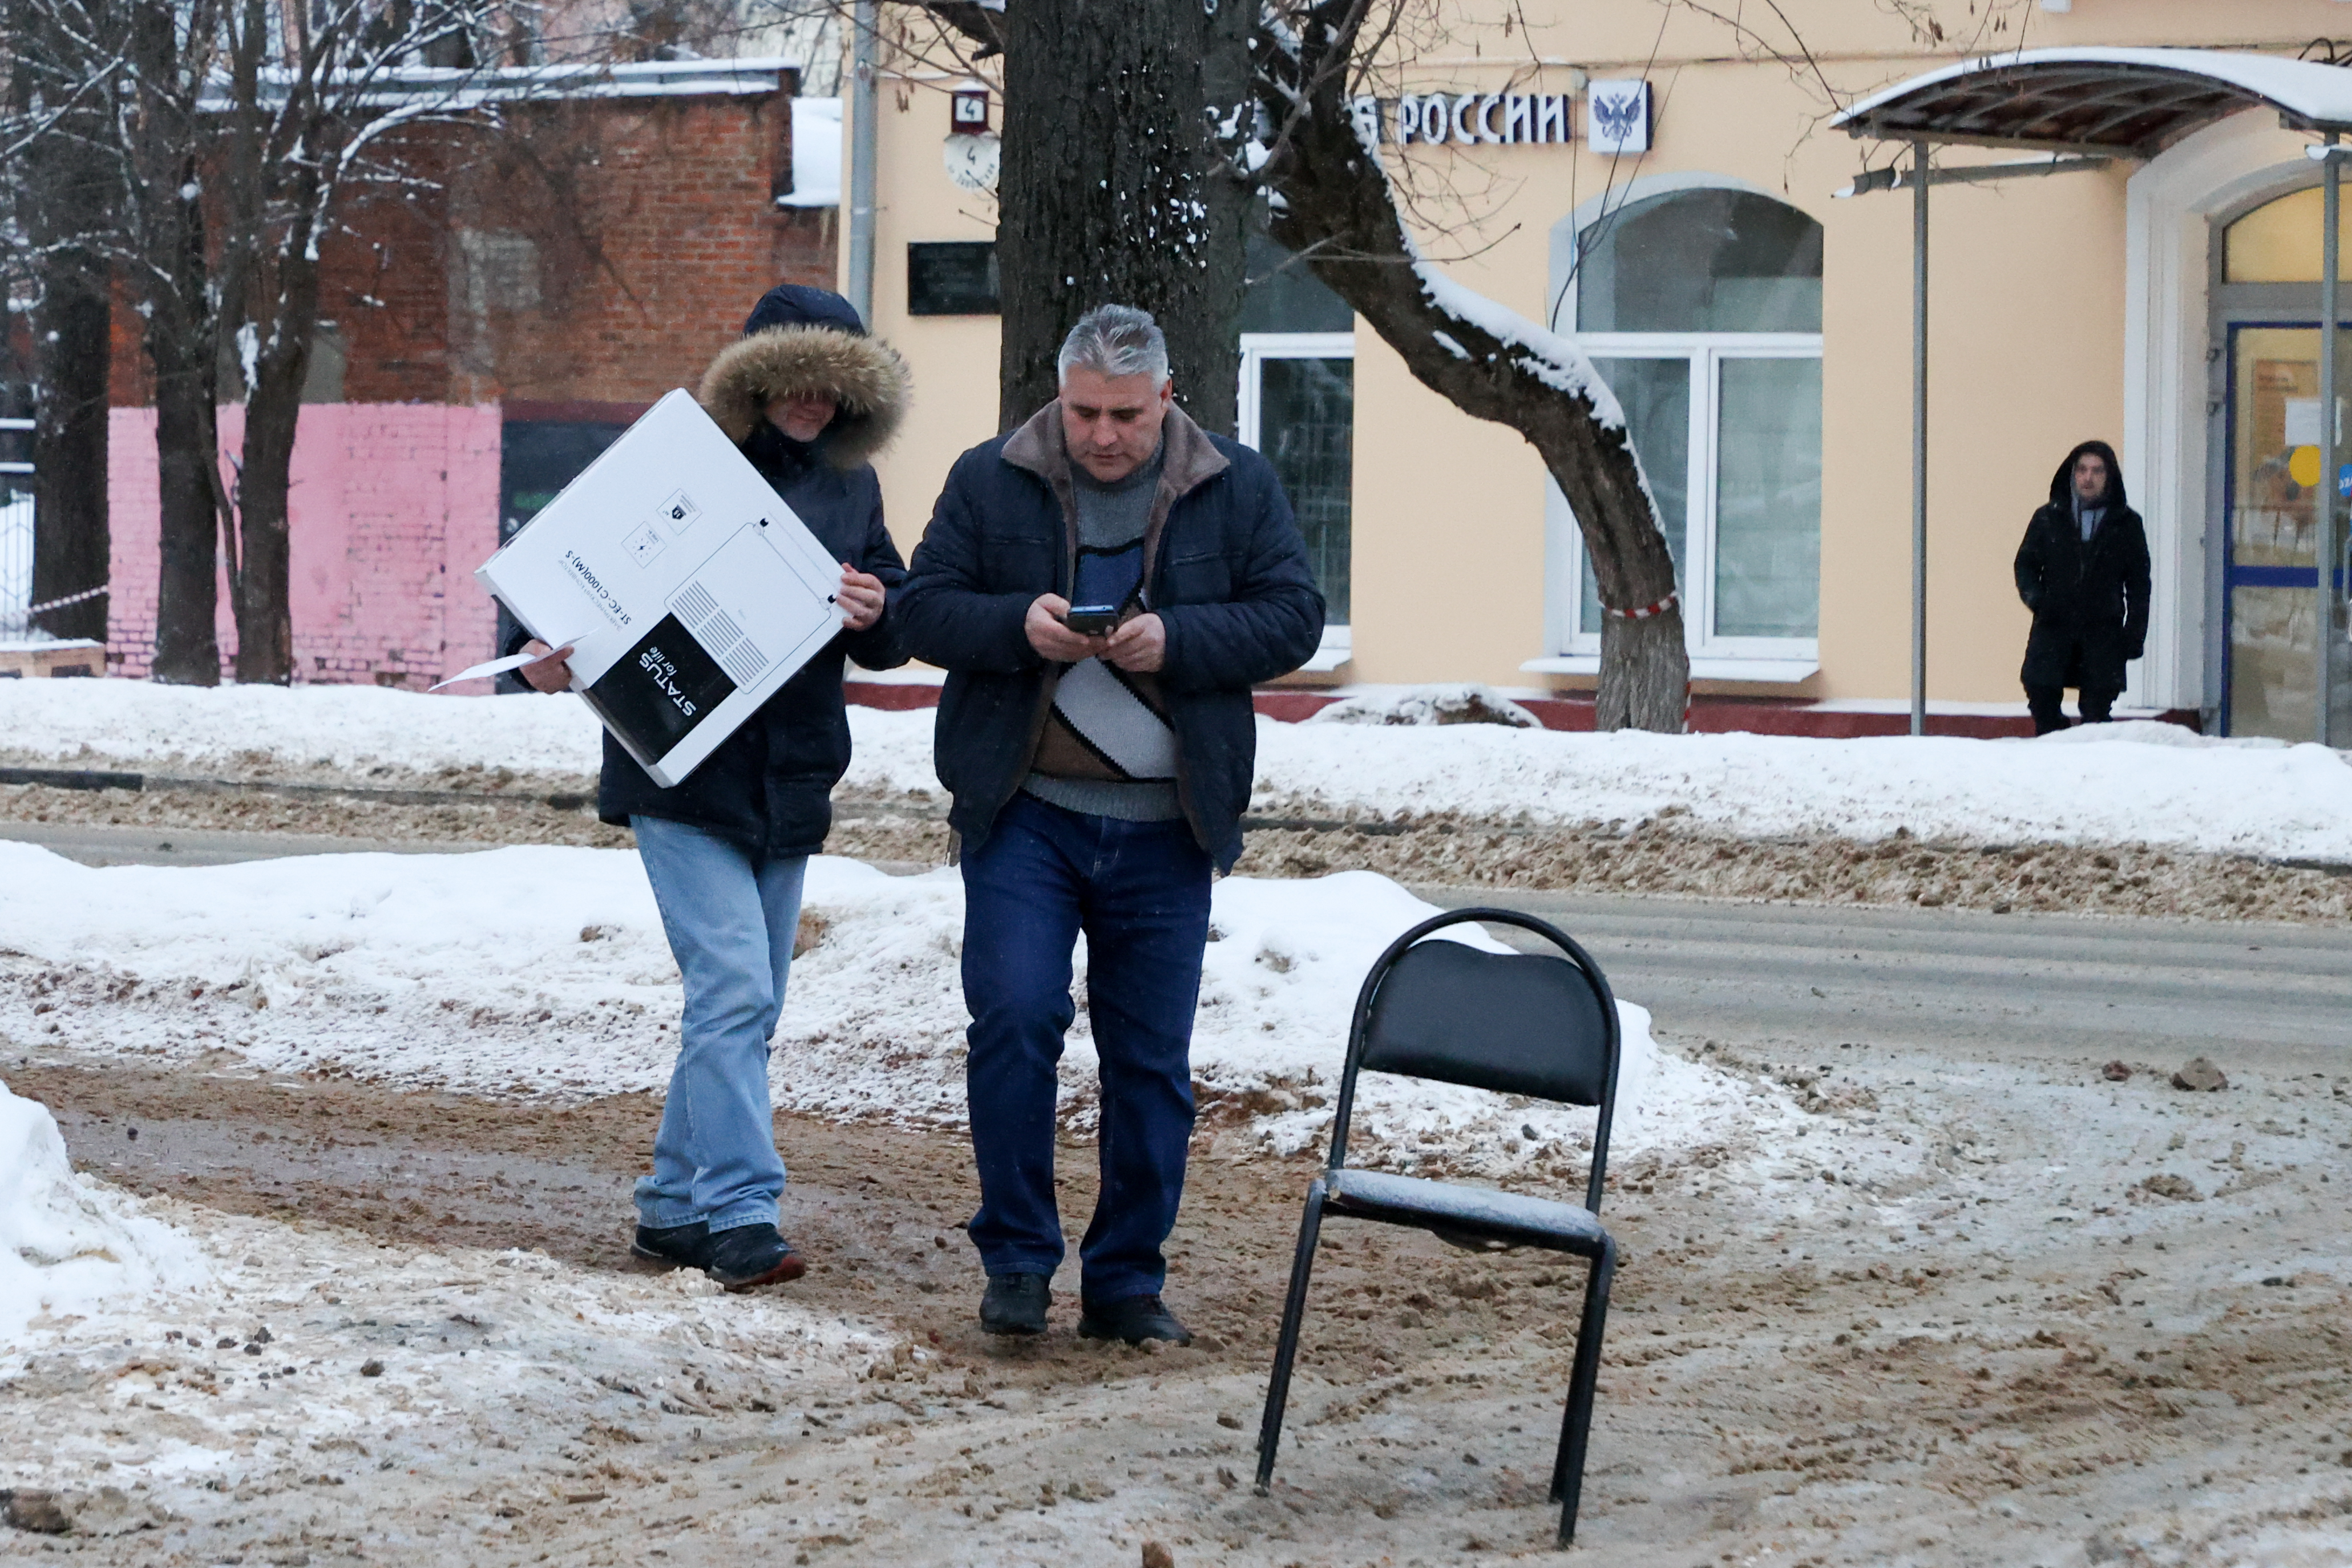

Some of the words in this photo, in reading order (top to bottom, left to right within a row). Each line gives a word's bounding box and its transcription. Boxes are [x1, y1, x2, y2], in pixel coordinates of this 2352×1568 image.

[1396, 92, 1566, 144] РОССИИ
[565, 550, 631, 624] ST-EC-C1000(M)-S
[649, 646, 665, 663] life
[661, 661, 677, 677] for
[639, 652, 696, 716] STATUS
